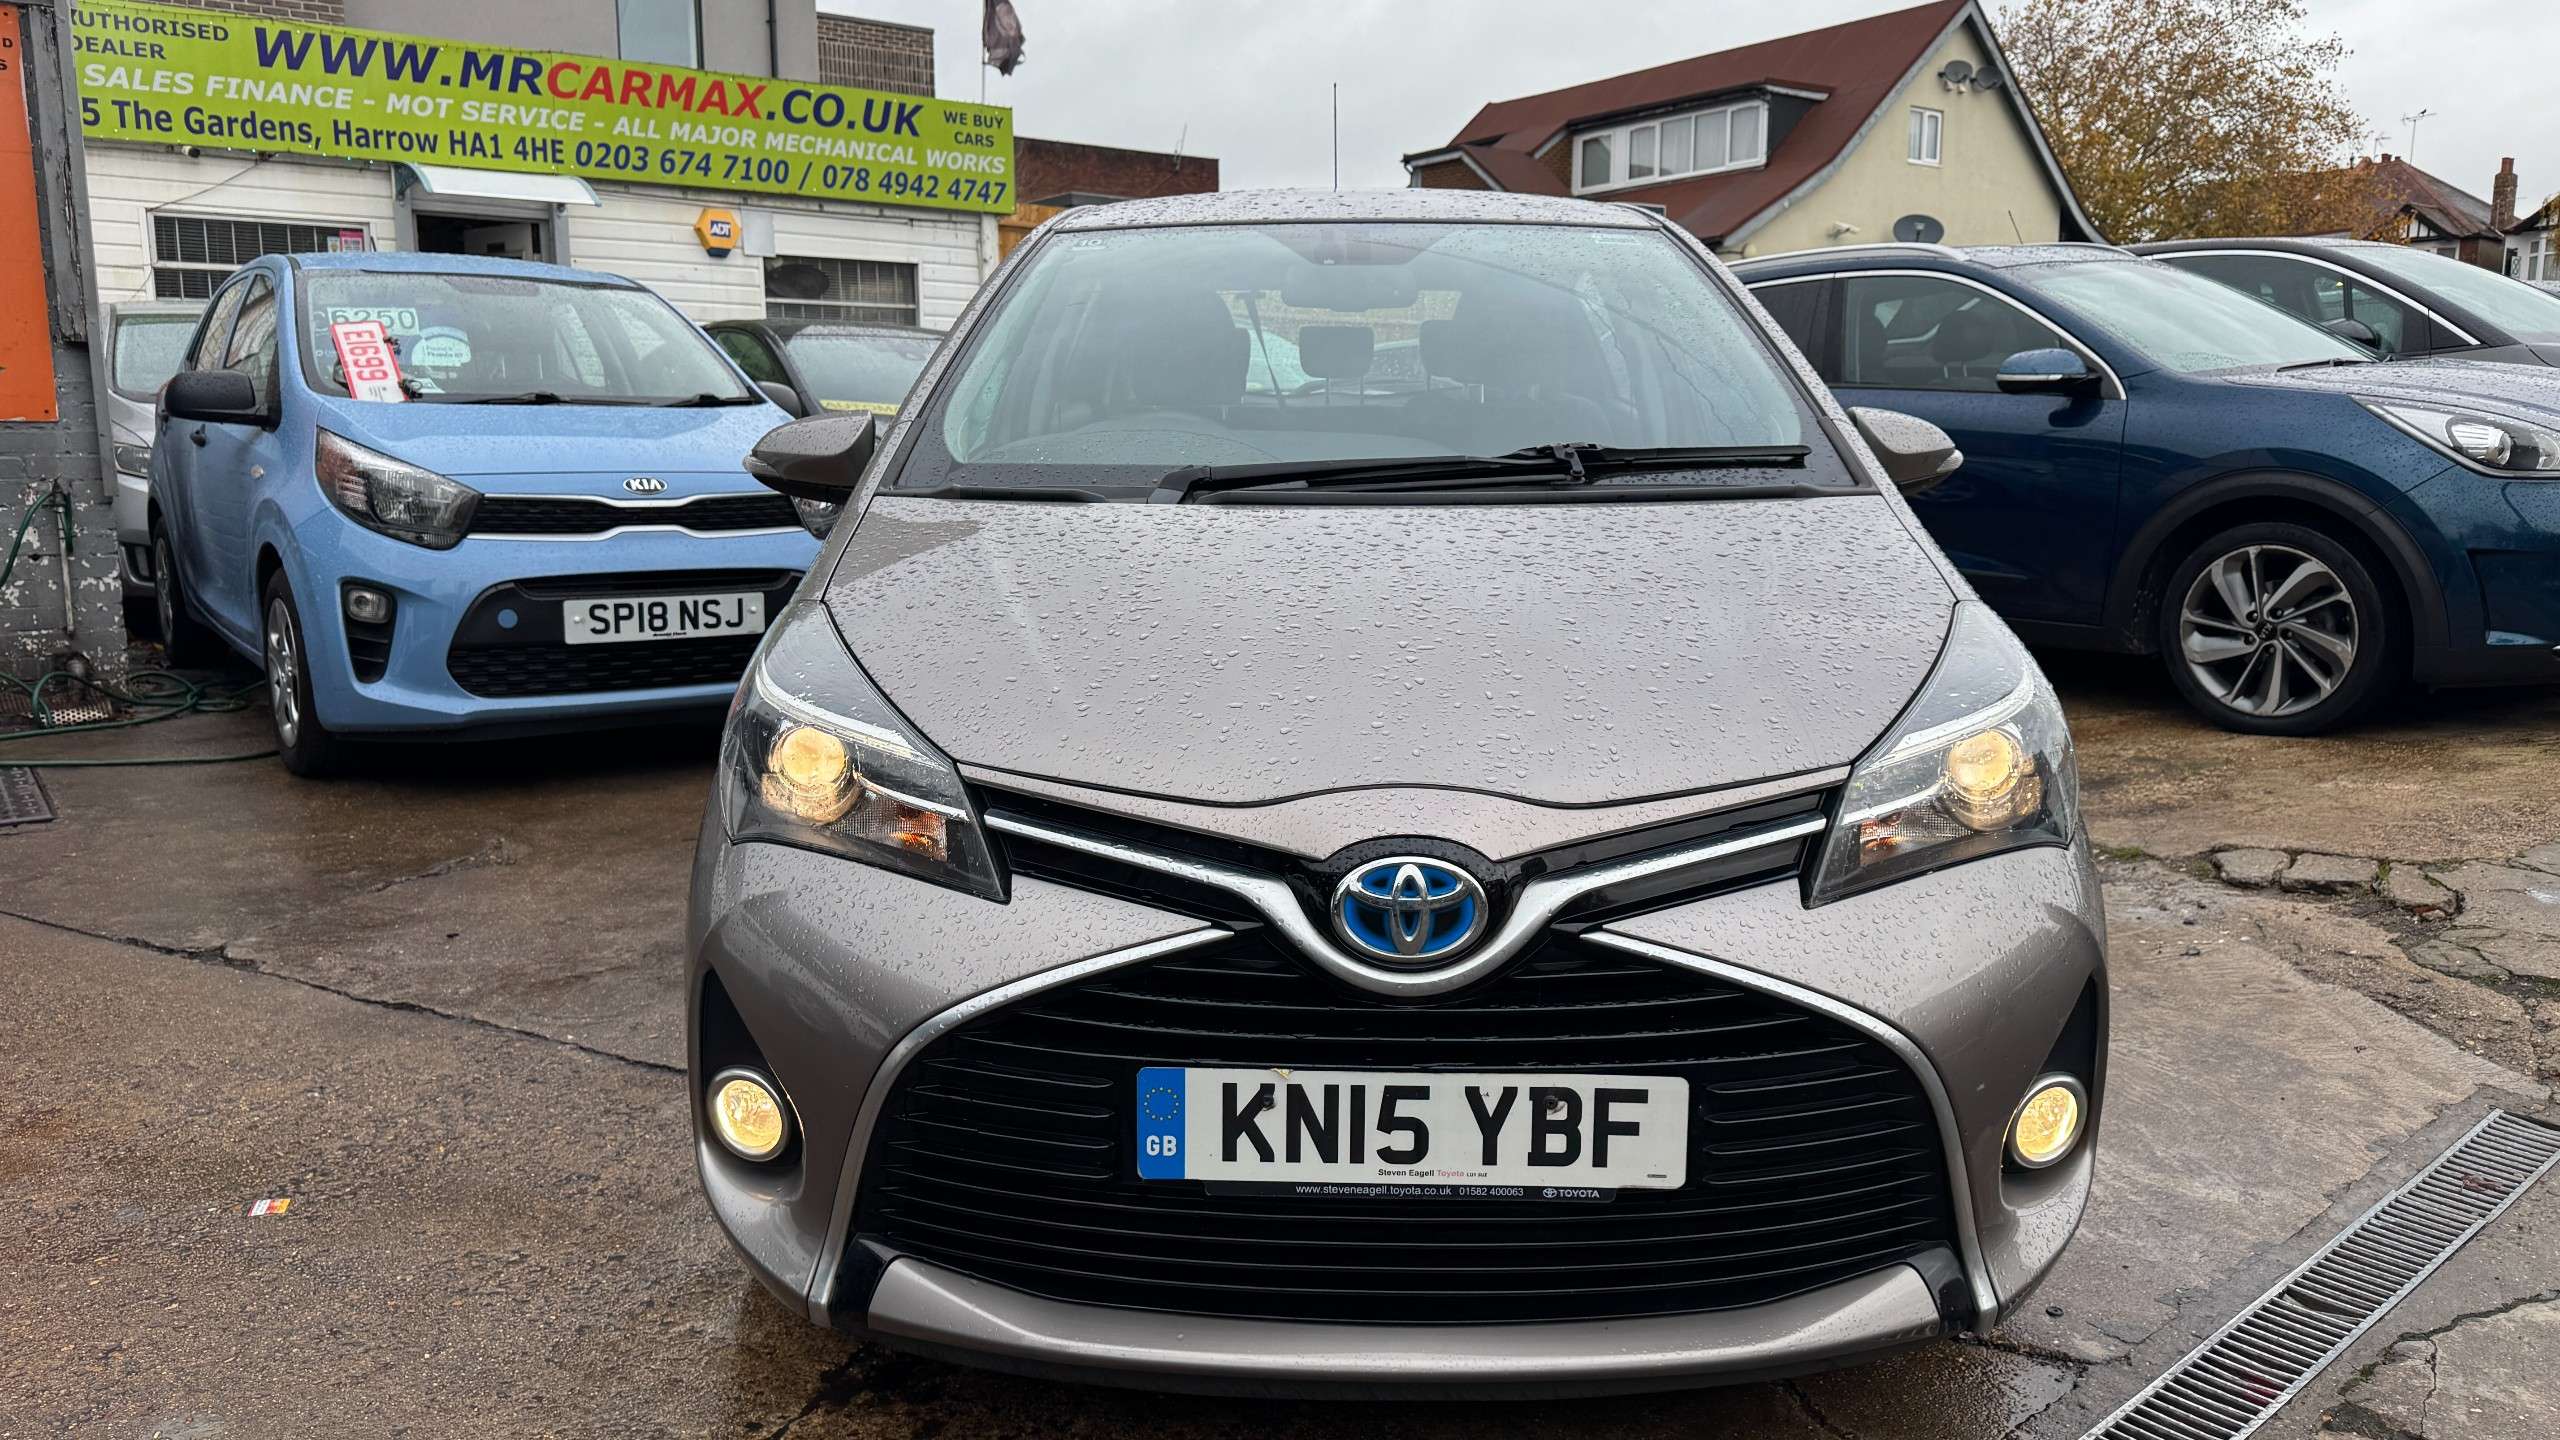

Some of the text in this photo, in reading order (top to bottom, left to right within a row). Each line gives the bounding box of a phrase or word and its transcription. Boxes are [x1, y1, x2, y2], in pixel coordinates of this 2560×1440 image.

[254, 26, 924, 137] WWW.MRCARMAX.CO.UK
[83, 63, 195, 95] SALES
[205, 75, 354, 110] FINANCE
[386, 93, 454, 119] MOT
[461, 99, 586, 132] SERVICE
[612, 116, 661, 140] ALL
[669, 121, 758, 149] MAJOR
[764, 131, 918, 166] MECHANICAL
[926, 148, 1006, 174] WORKS
[944, 110, 1004, 129] WE BUY
[954, 131, 994, 148] CARS
[111, 99, 173, 133] The
[184, 106, 321, 150] Gardens,
[332, 119, 438, 154] Harrow
[449, 129, 503, 160] HA1
[513, 135, 565, 165] 4HE
[575, 140, 649, 173] 0203
[660, 149, 712, 178] 674
[722, 154, 790, 184] 7100
[798, 161, 813, 191] /
[823, 164, 870, 193] 078
[879, 171, 939, 199] 4942
[947, 177, 1007, 204] 4747
[710, 221, 732, 237] ADT
[630, 477, 662, 491] KIA
[588, 597, 744, 635] SP18 NSJ
[1221, 1083, 1649, 1168] KN15 YBF
[1146, 1135, 1178, 1156] GB
[1377, 1168, 1407, 1177] Steven
[1409, 1169, 1435, 1178] Eagell
[1437, 1169, 1465, 1178] Toyota
[1295, 1184, 1524, 1198] www.steveneagell.toyota.co.uk 01582 400063
[1559, 1189, 1600, 1198] TOYOTA
